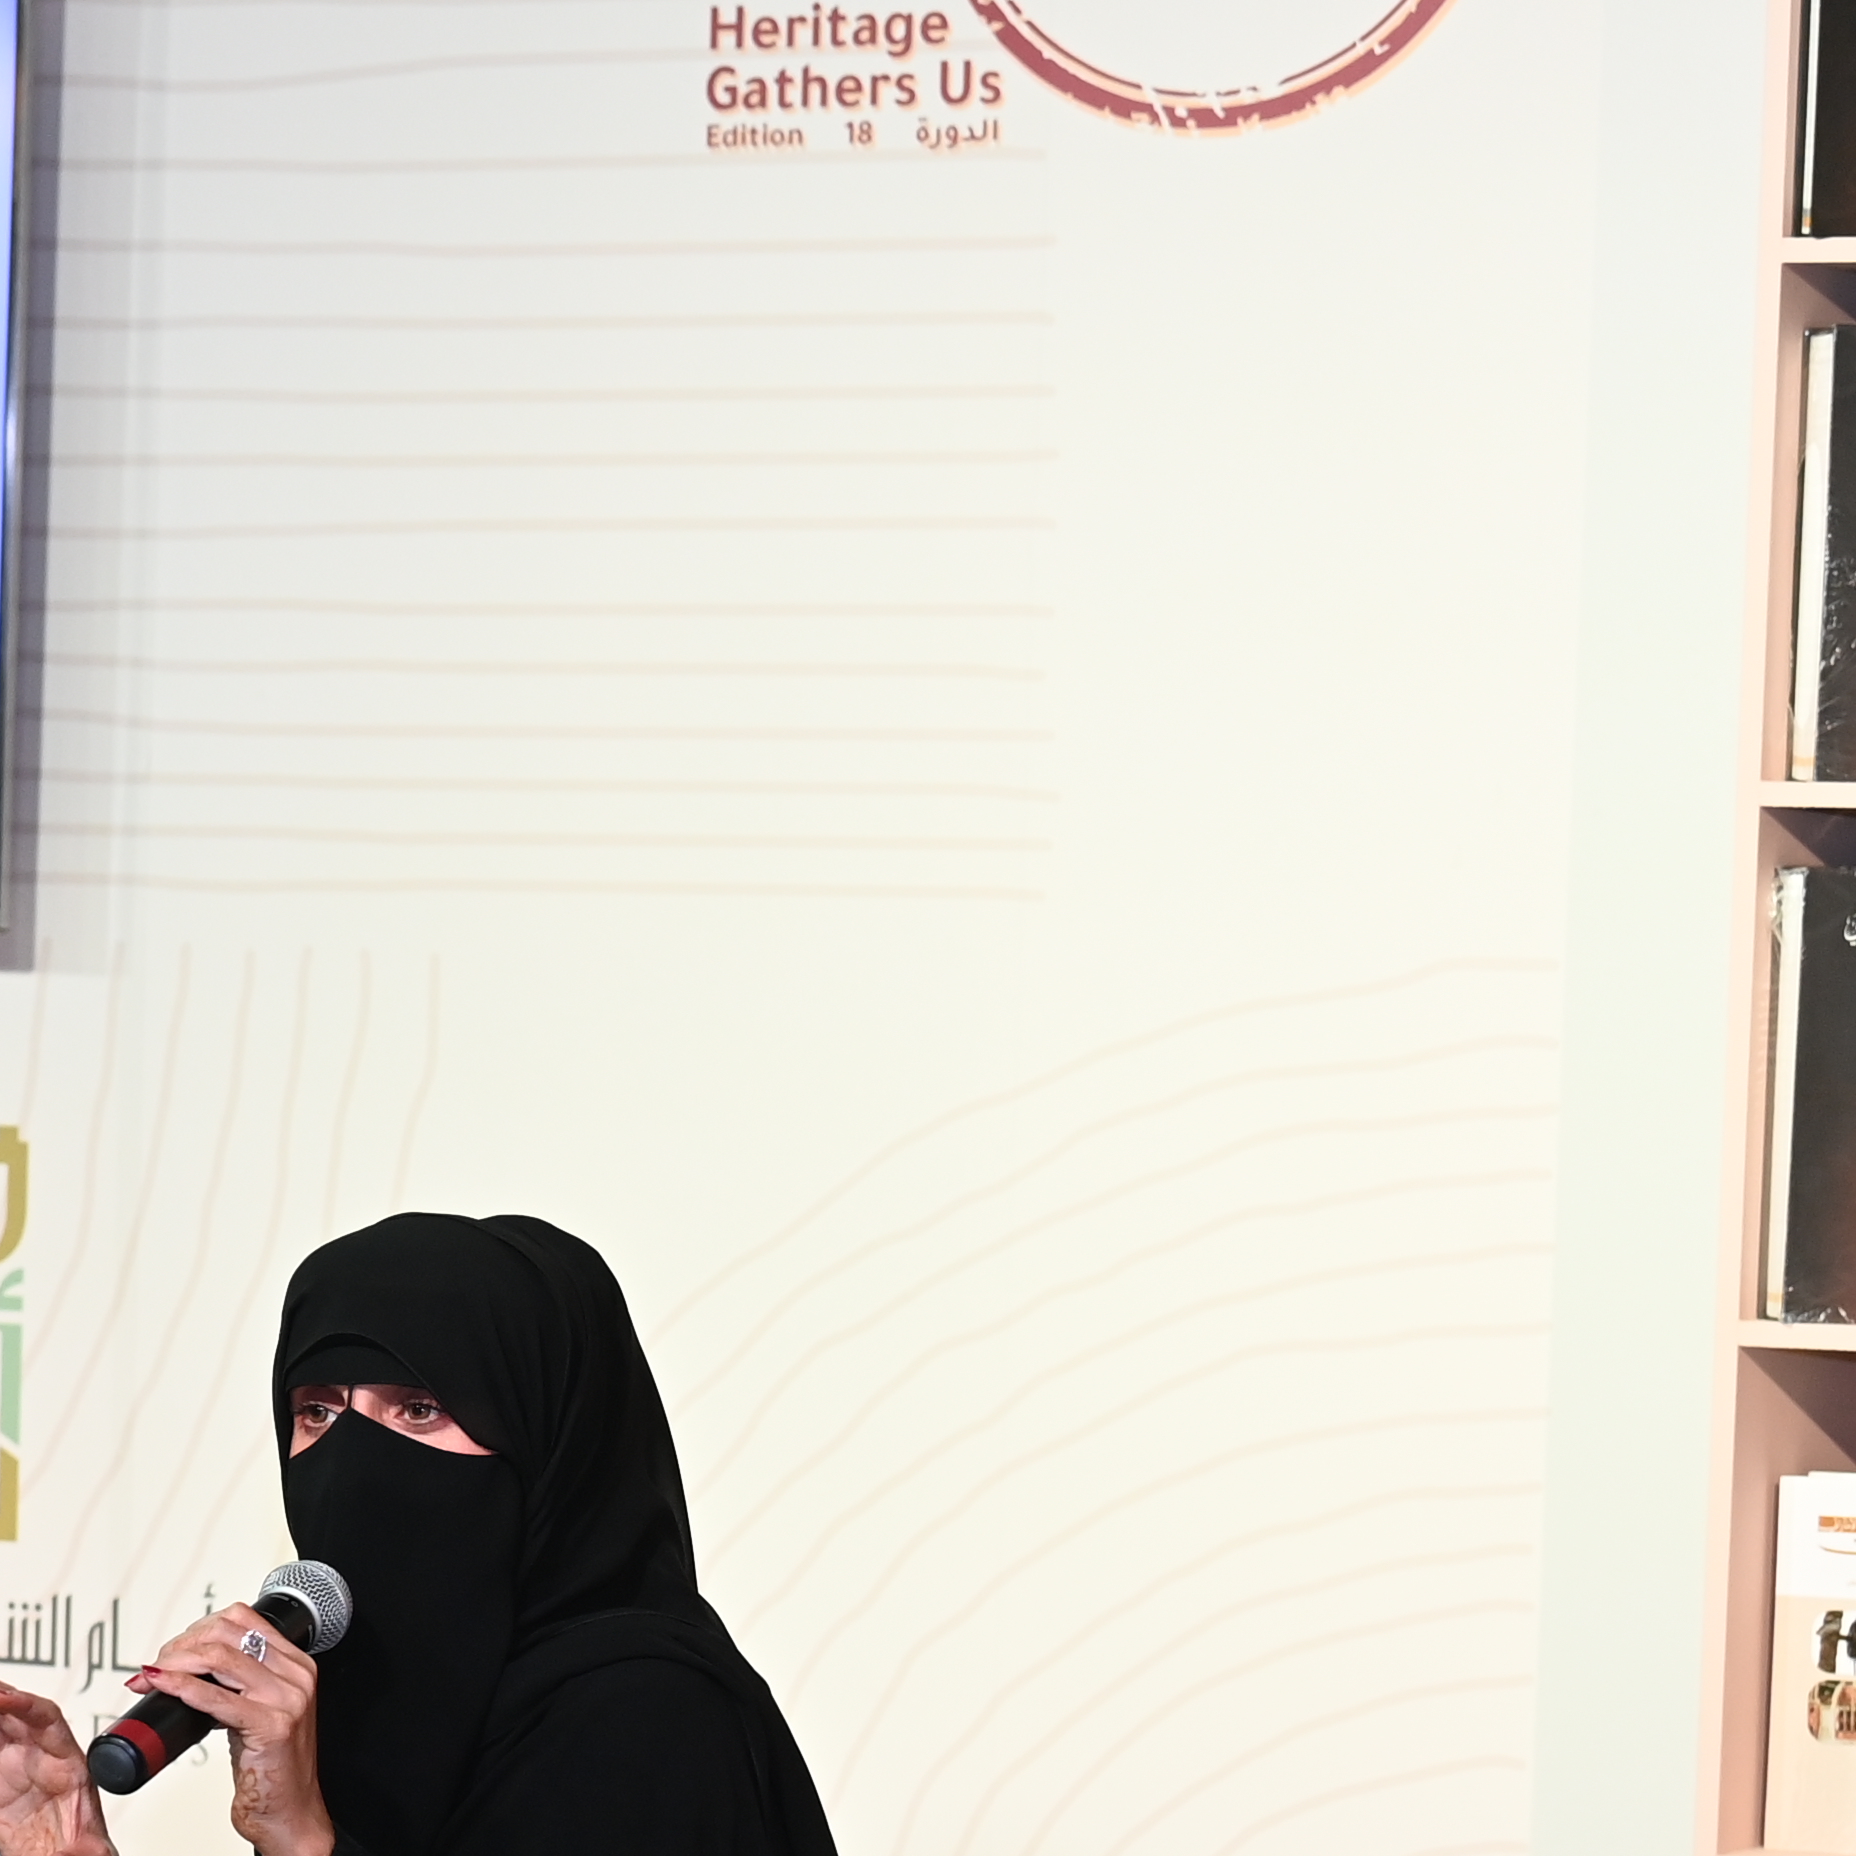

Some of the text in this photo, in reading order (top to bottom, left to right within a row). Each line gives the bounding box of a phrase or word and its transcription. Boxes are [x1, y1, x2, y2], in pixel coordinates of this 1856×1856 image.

[709, 3, 949, 56] Heritage
[706, 60, 1003, 111] Gathers Us
[706, 117, 1001, 150] Edition 18 الدورة
